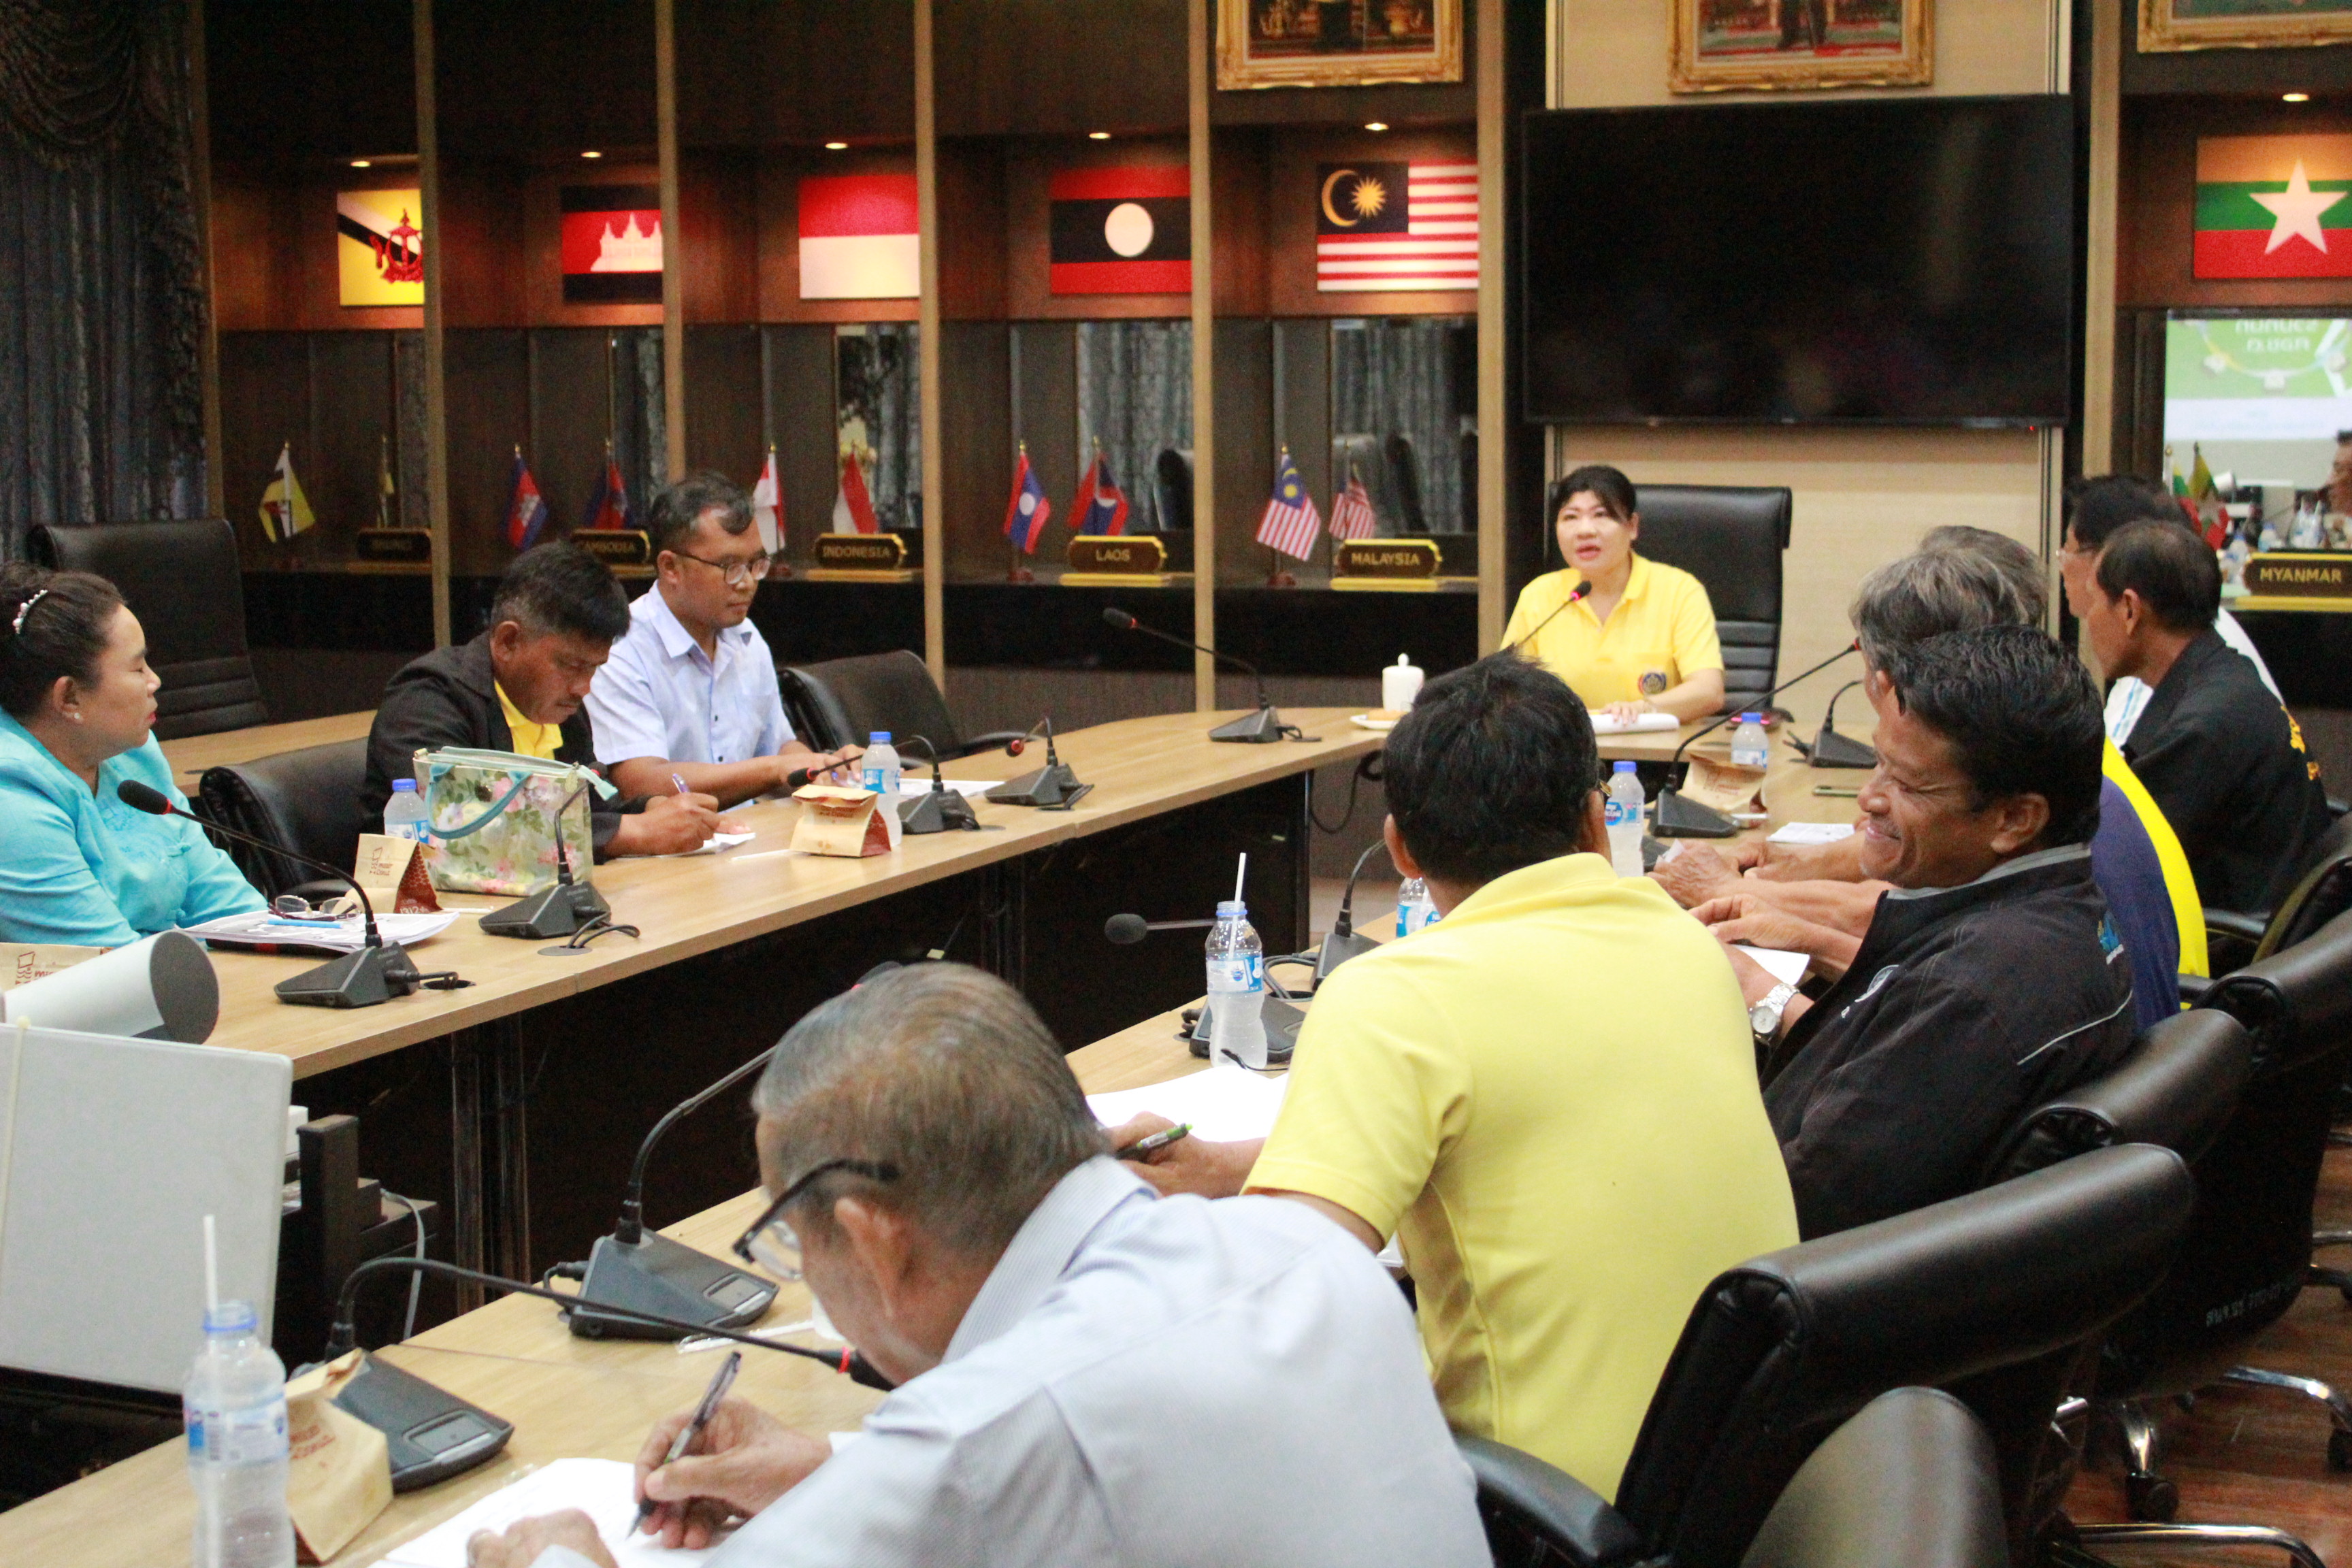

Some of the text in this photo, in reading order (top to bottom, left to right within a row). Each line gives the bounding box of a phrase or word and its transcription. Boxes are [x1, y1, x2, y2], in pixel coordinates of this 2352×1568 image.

[823, 546, 889, 557] INDONESIA
[1096, 549, 1130, 561] LAOS
[1351, 552, 1420, 566] MALAYSIA
[2260, 568, 2341, 582] MYANMAR
